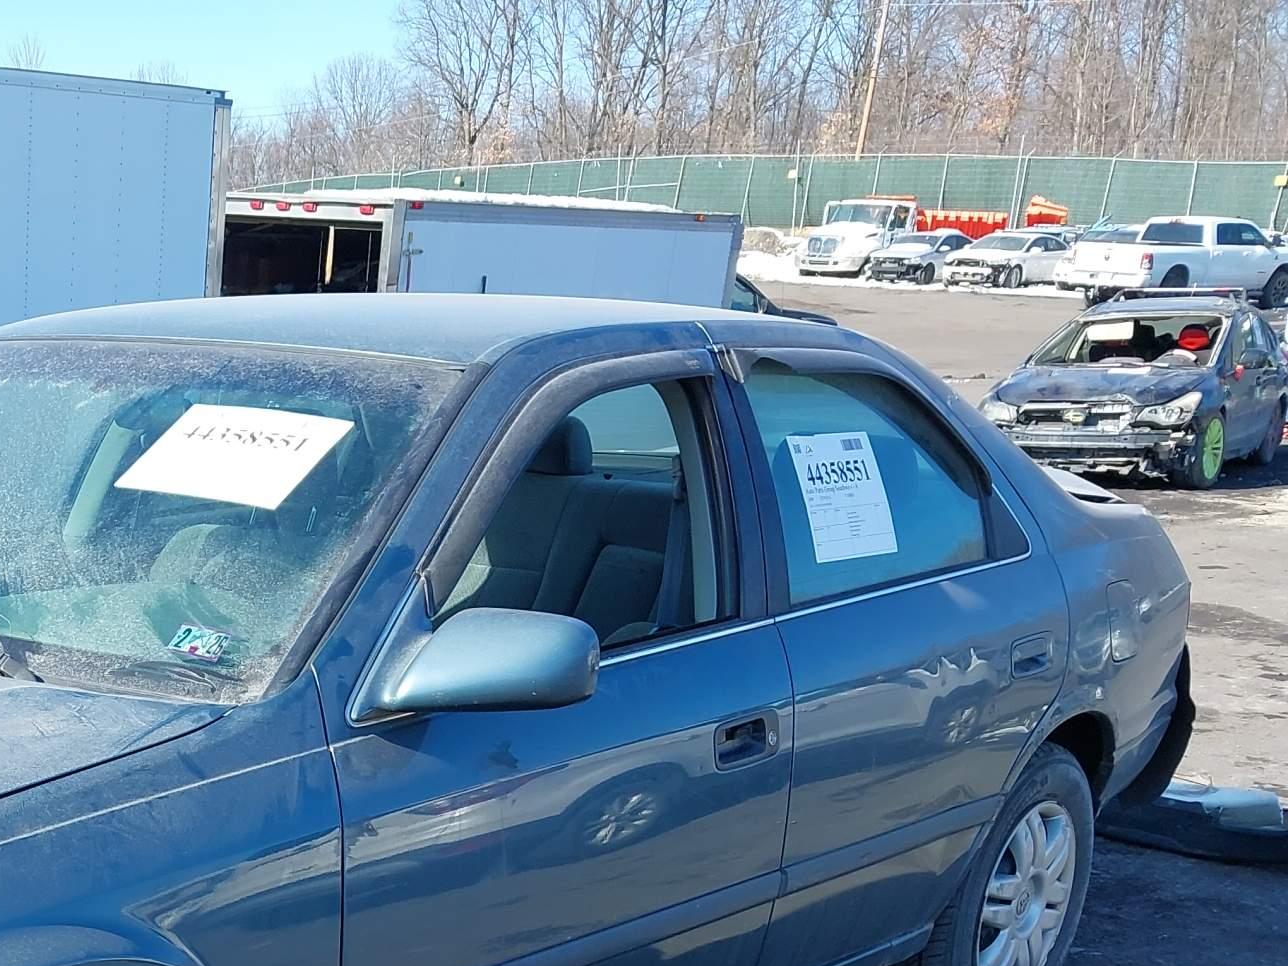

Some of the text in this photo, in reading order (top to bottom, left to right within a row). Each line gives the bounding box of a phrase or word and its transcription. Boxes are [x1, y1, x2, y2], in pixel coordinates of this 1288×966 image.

[184, 426, 309, 452] 44358551
[807, 459, 871, 486] 44358551
[173, 627, 229, 656] 2 26
